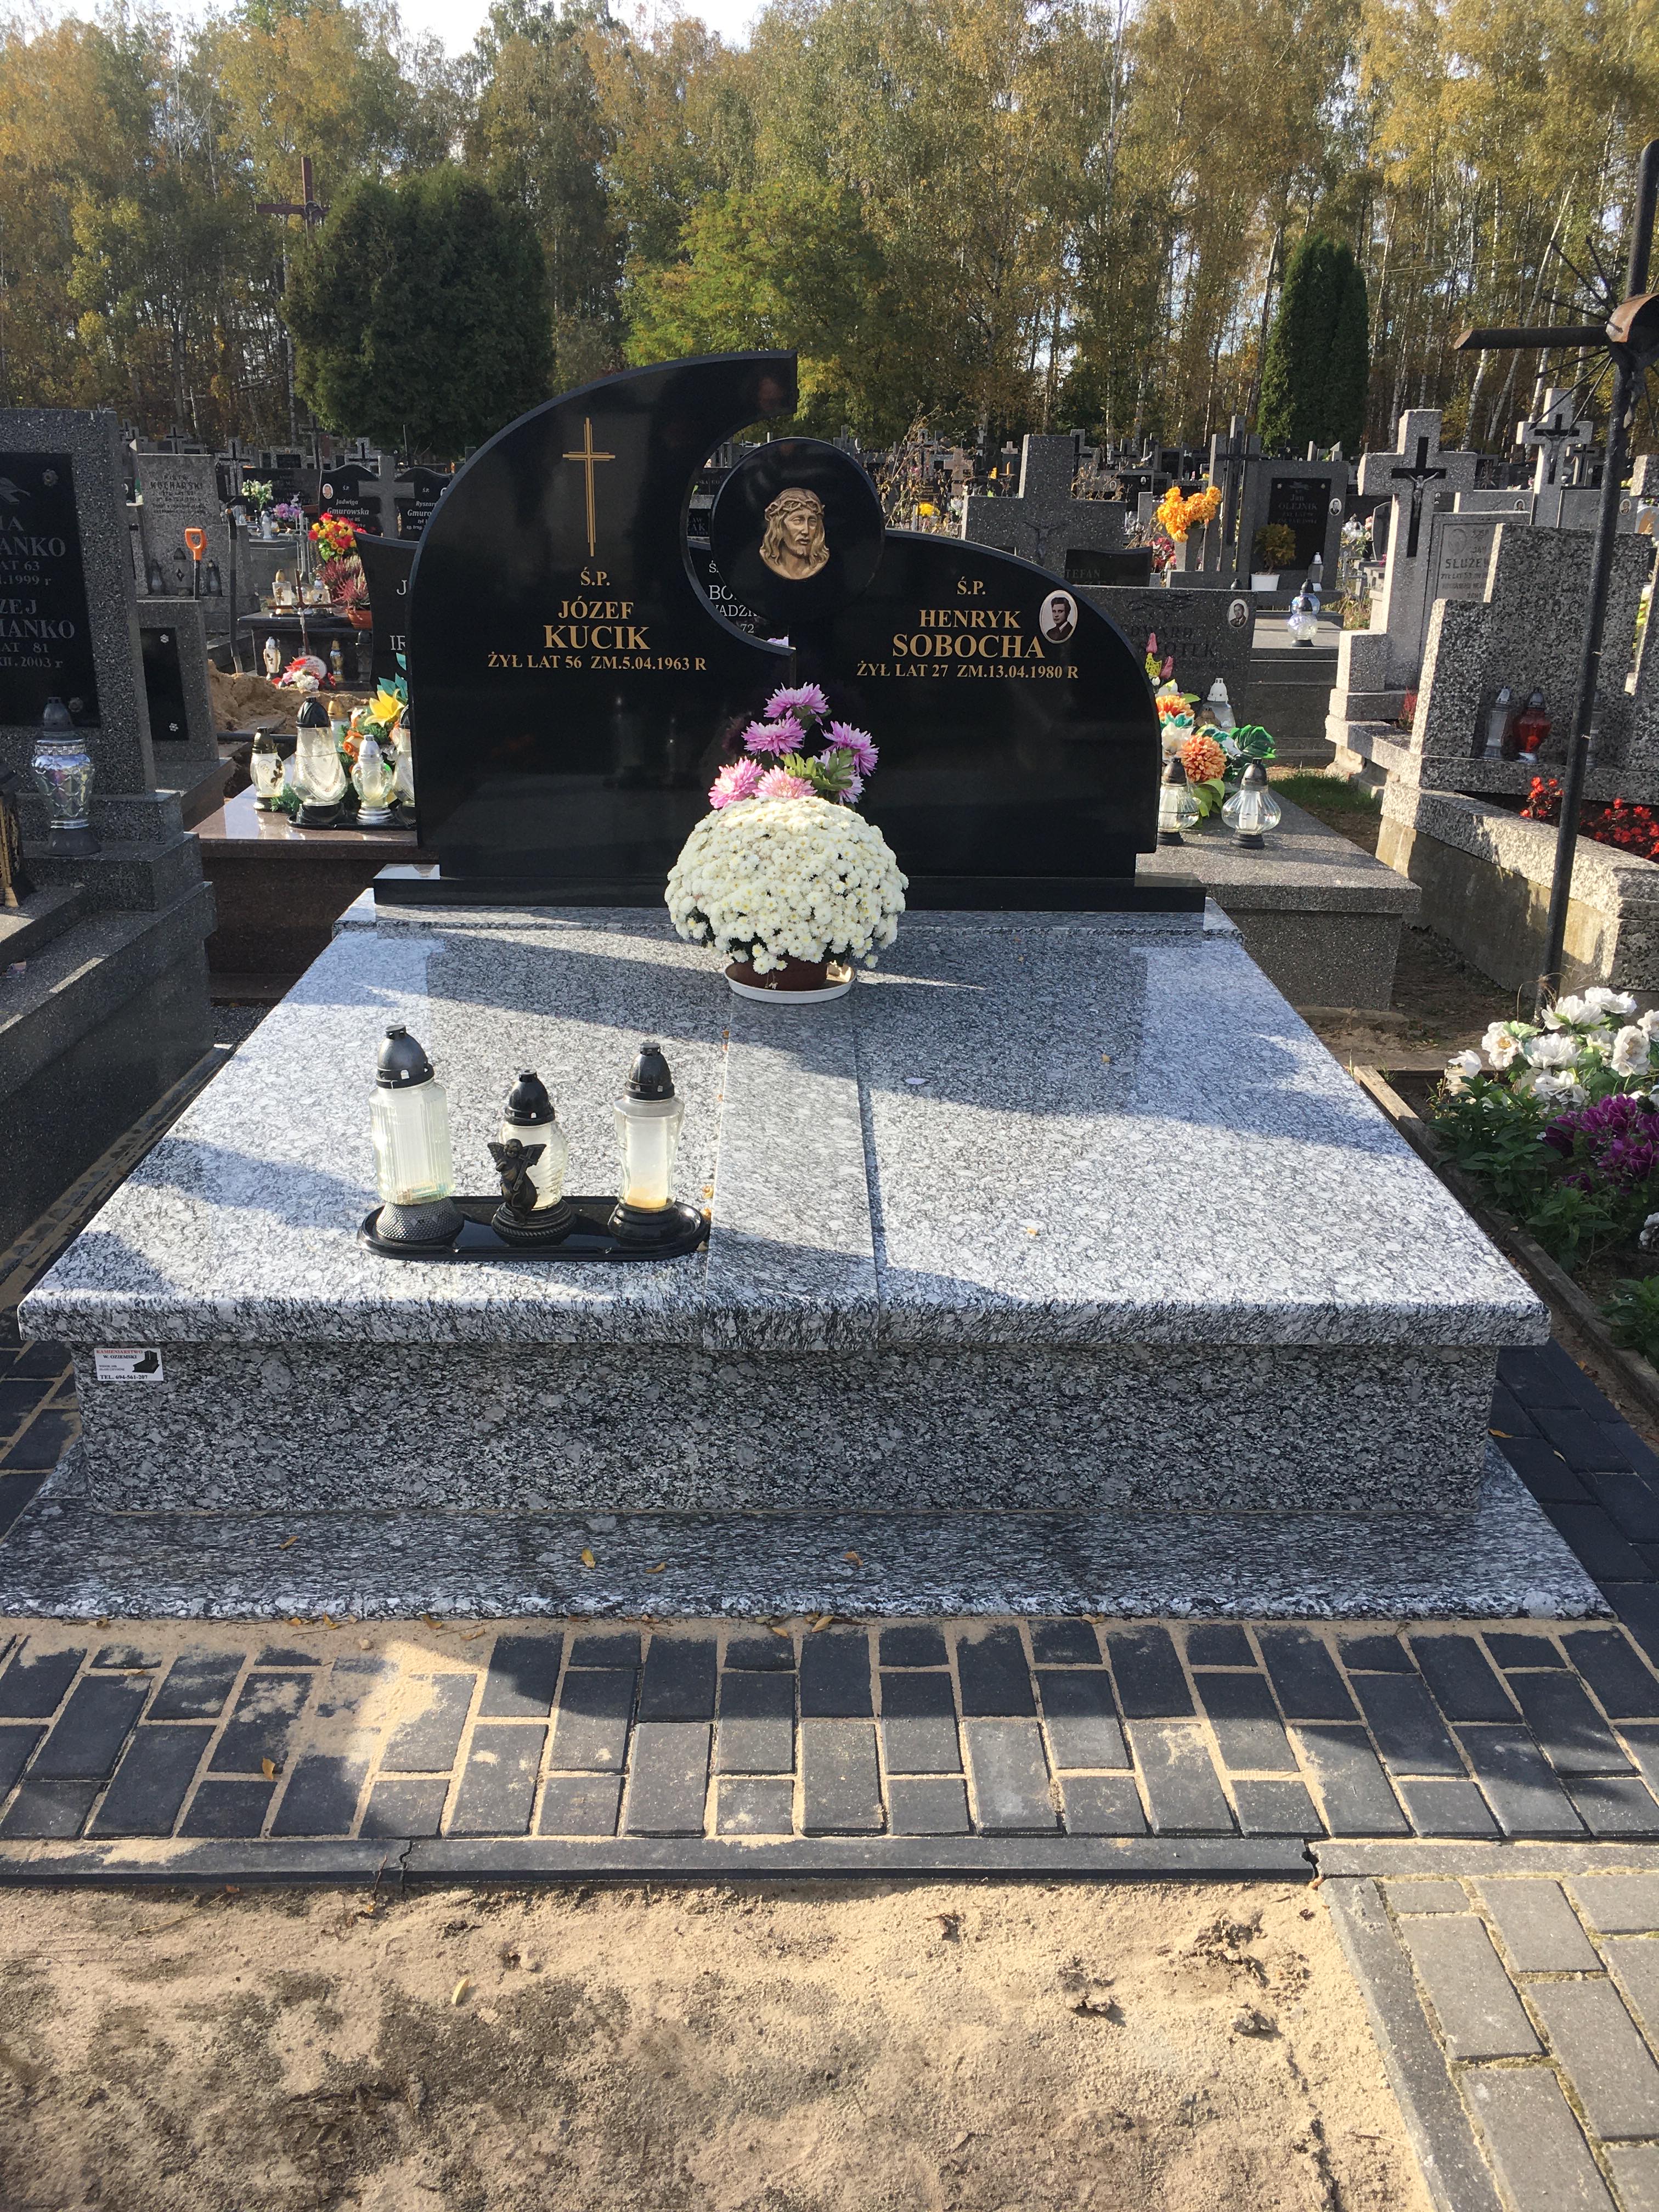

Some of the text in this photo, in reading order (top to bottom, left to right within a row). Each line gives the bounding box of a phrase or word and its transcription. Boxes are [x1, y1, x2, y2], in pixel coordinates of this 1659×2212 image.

[24, 561, 40, 571] 63
[580, 567, 611, 586] Ś.P.
[957, 576, 986, 595] Ś.P.
[558, 596, 634, 619] JÓZEF
[918, 610, 1021, 628] HENRYK
[543, 625, 651, 650] KUCIK
[893, 634, 1045, 658] SOBOCHA
[33, 642, 49, 653] 81
[488, 651, 707, 671] ŻYŁ LAT 56 ZM.5.04.1963 R
[856, 660, 1079, 679] ŻYŁ LAT 27 ZM.13.04.1980 R
